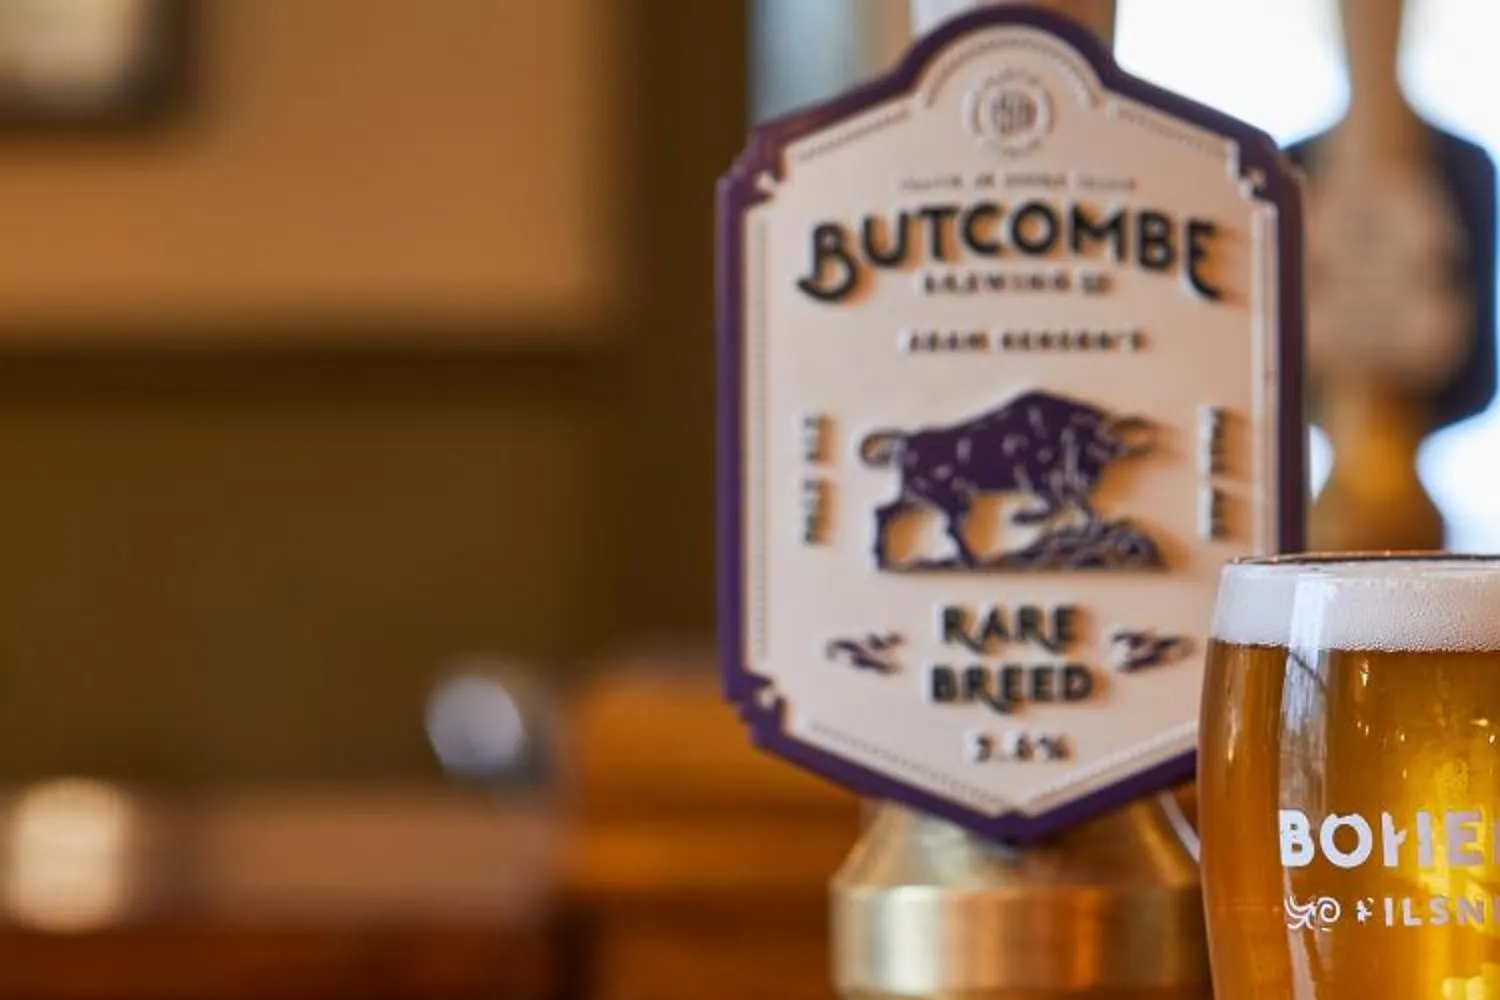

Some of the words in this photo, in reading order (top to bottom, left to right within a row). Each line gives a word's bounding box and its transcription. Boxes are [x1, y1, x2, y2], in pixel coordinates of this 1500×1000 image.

[797, 200, 1221, 301] BUTCOMBE
[943, 604, 1080, 655] RARE
[931, 664, 1094, 716] BREED
